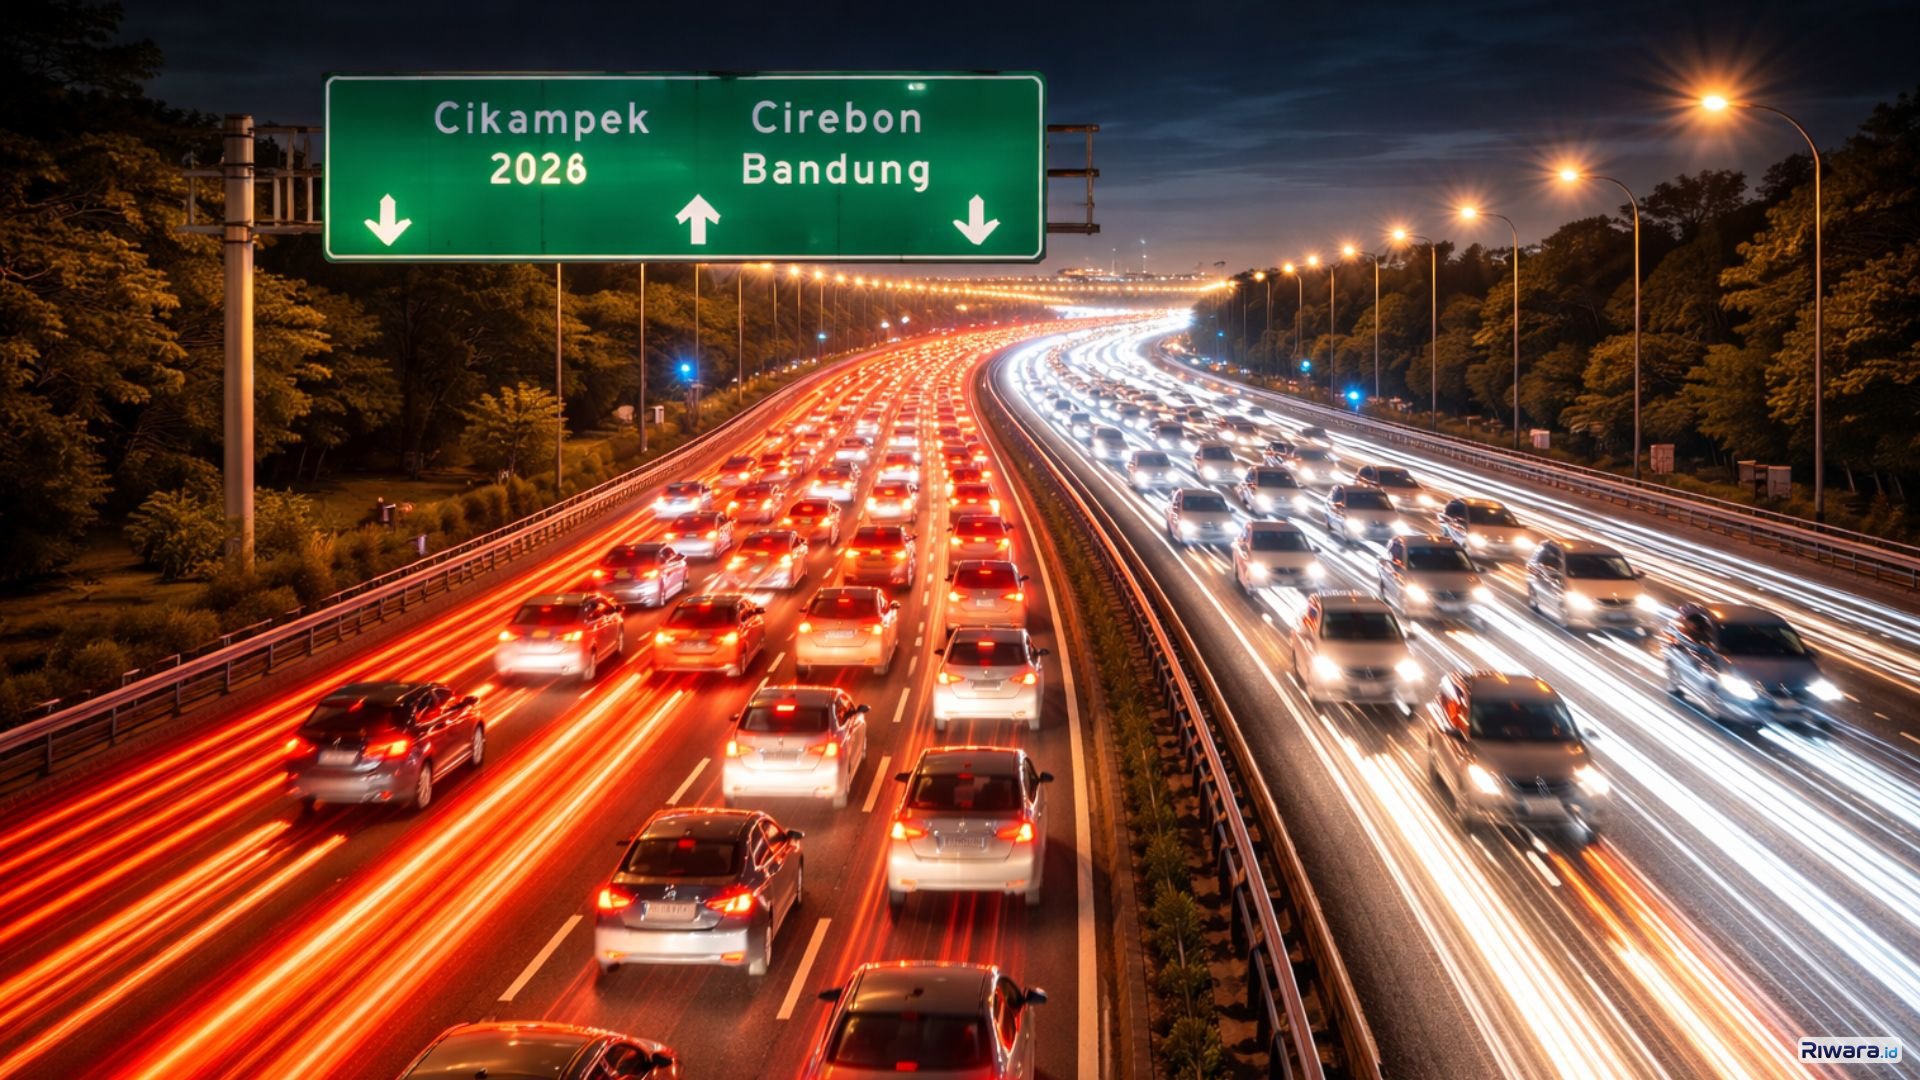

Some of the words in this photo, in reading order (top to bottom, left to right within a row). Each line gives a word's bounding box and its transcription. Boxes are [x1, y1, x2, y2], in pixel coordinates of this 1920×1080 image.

[434, 101, 650, 141] Cikampek
[752, 100, 922, 134] Cirebon
[489, 151, 588, 186] 2026
[742, 152, 930, 193] Bandung
